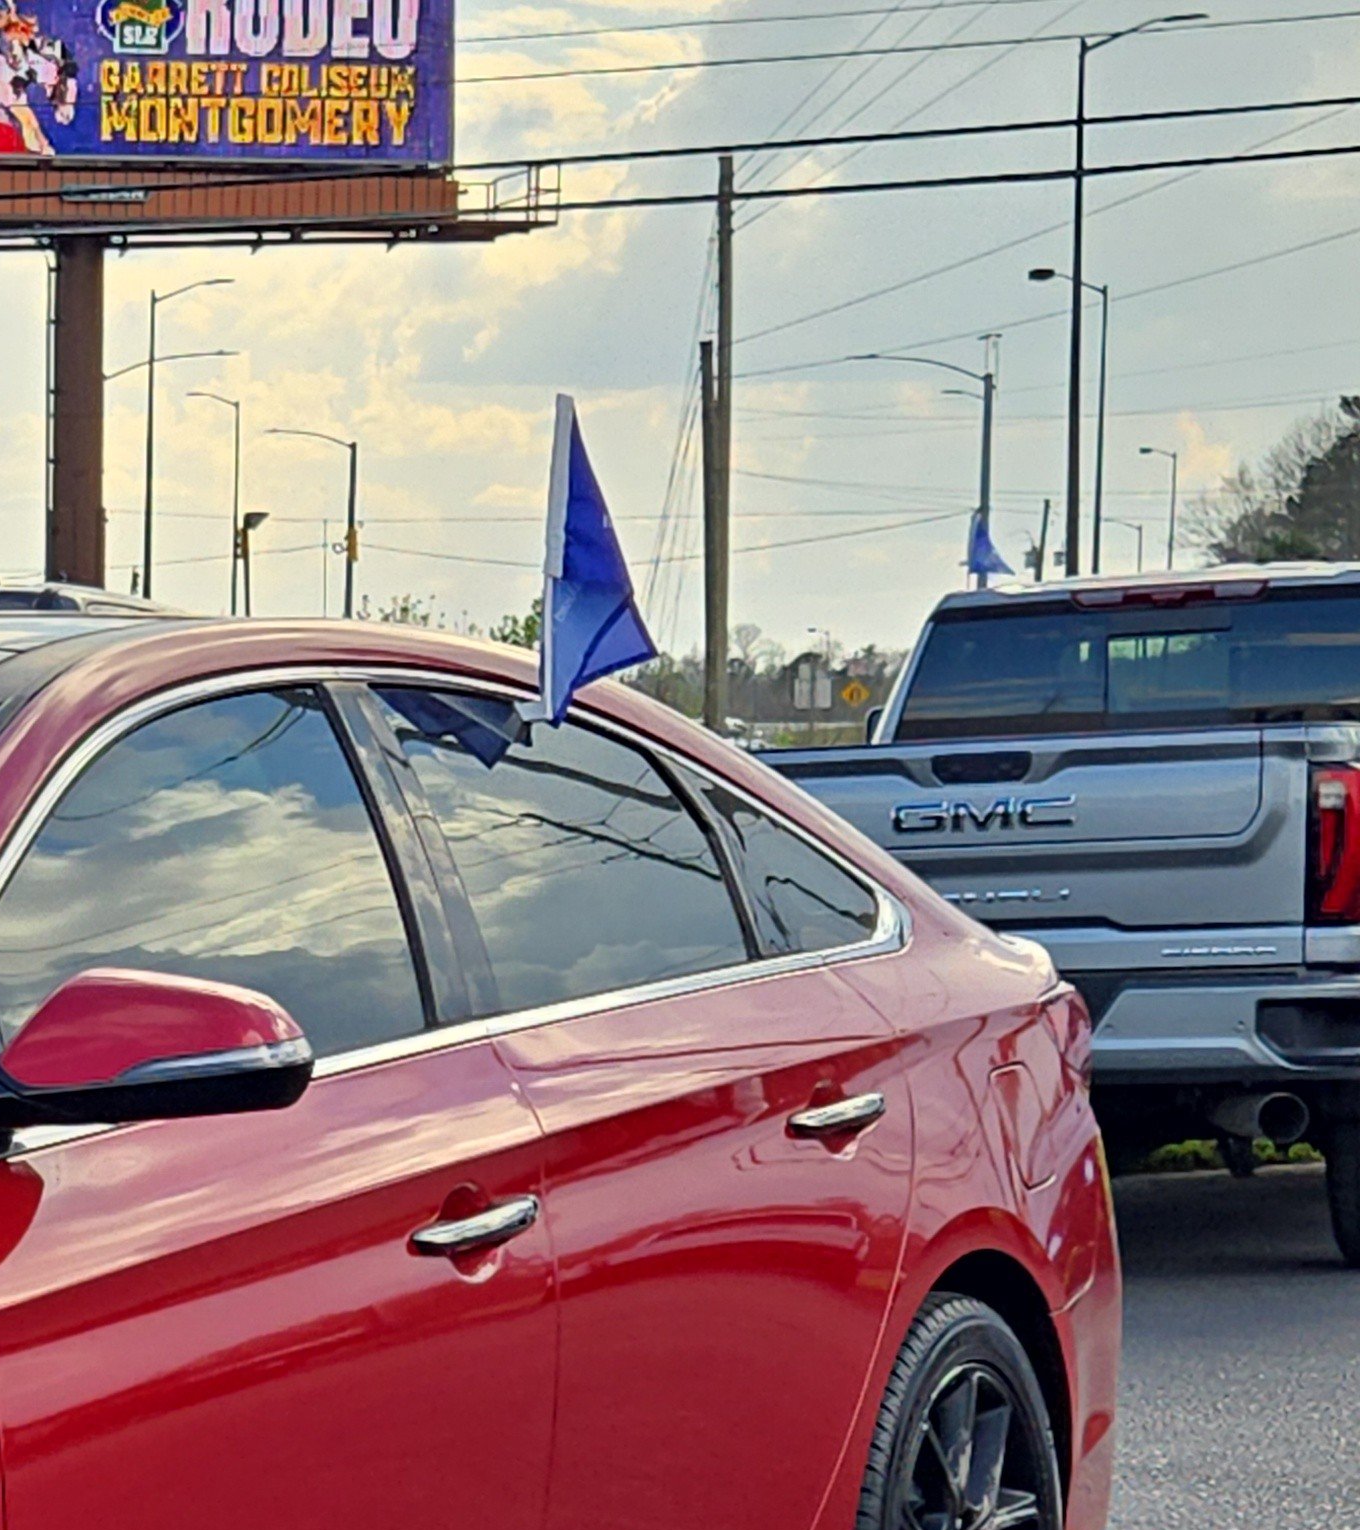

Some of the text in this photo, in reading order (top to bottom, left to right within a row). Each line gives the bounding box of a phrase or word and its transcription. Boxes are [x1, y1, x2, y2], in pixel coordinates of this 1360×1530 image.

[185, 0, 420, 59] RODEO
[99, 59, 417, 99] GARRETT COLISEUM
[99, 96, 416, 146] MONTGOMERY
[889, 794, 1076, 832] GMC
